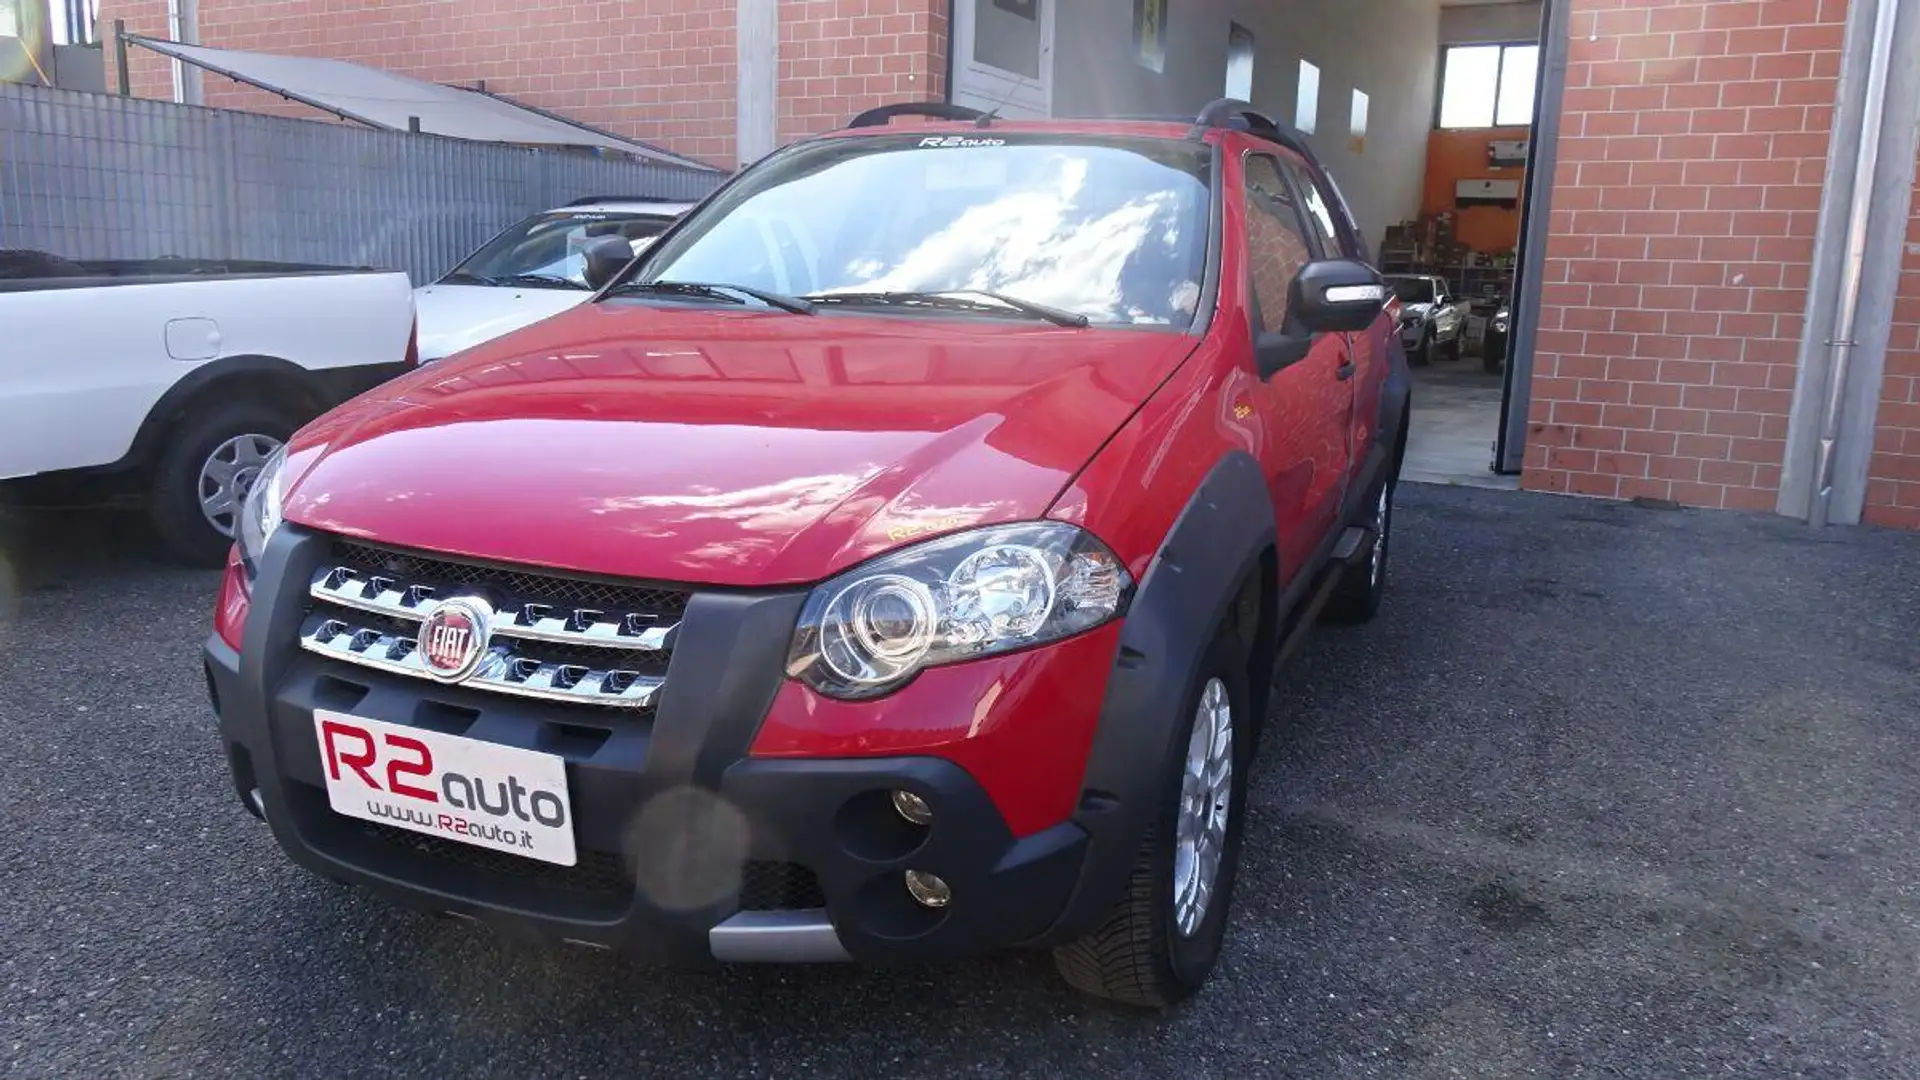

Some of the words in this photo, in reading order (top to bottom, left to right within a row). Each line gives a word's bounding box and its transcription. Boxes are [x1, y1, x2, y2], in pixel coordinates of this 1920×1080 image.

[918, 135, 1006, 148] R2auto
[431, 625, 469, 659] FIAT
[321, 719, 566, 829] R2auto
[366, 800, 534, 850] www.R2auto.it
